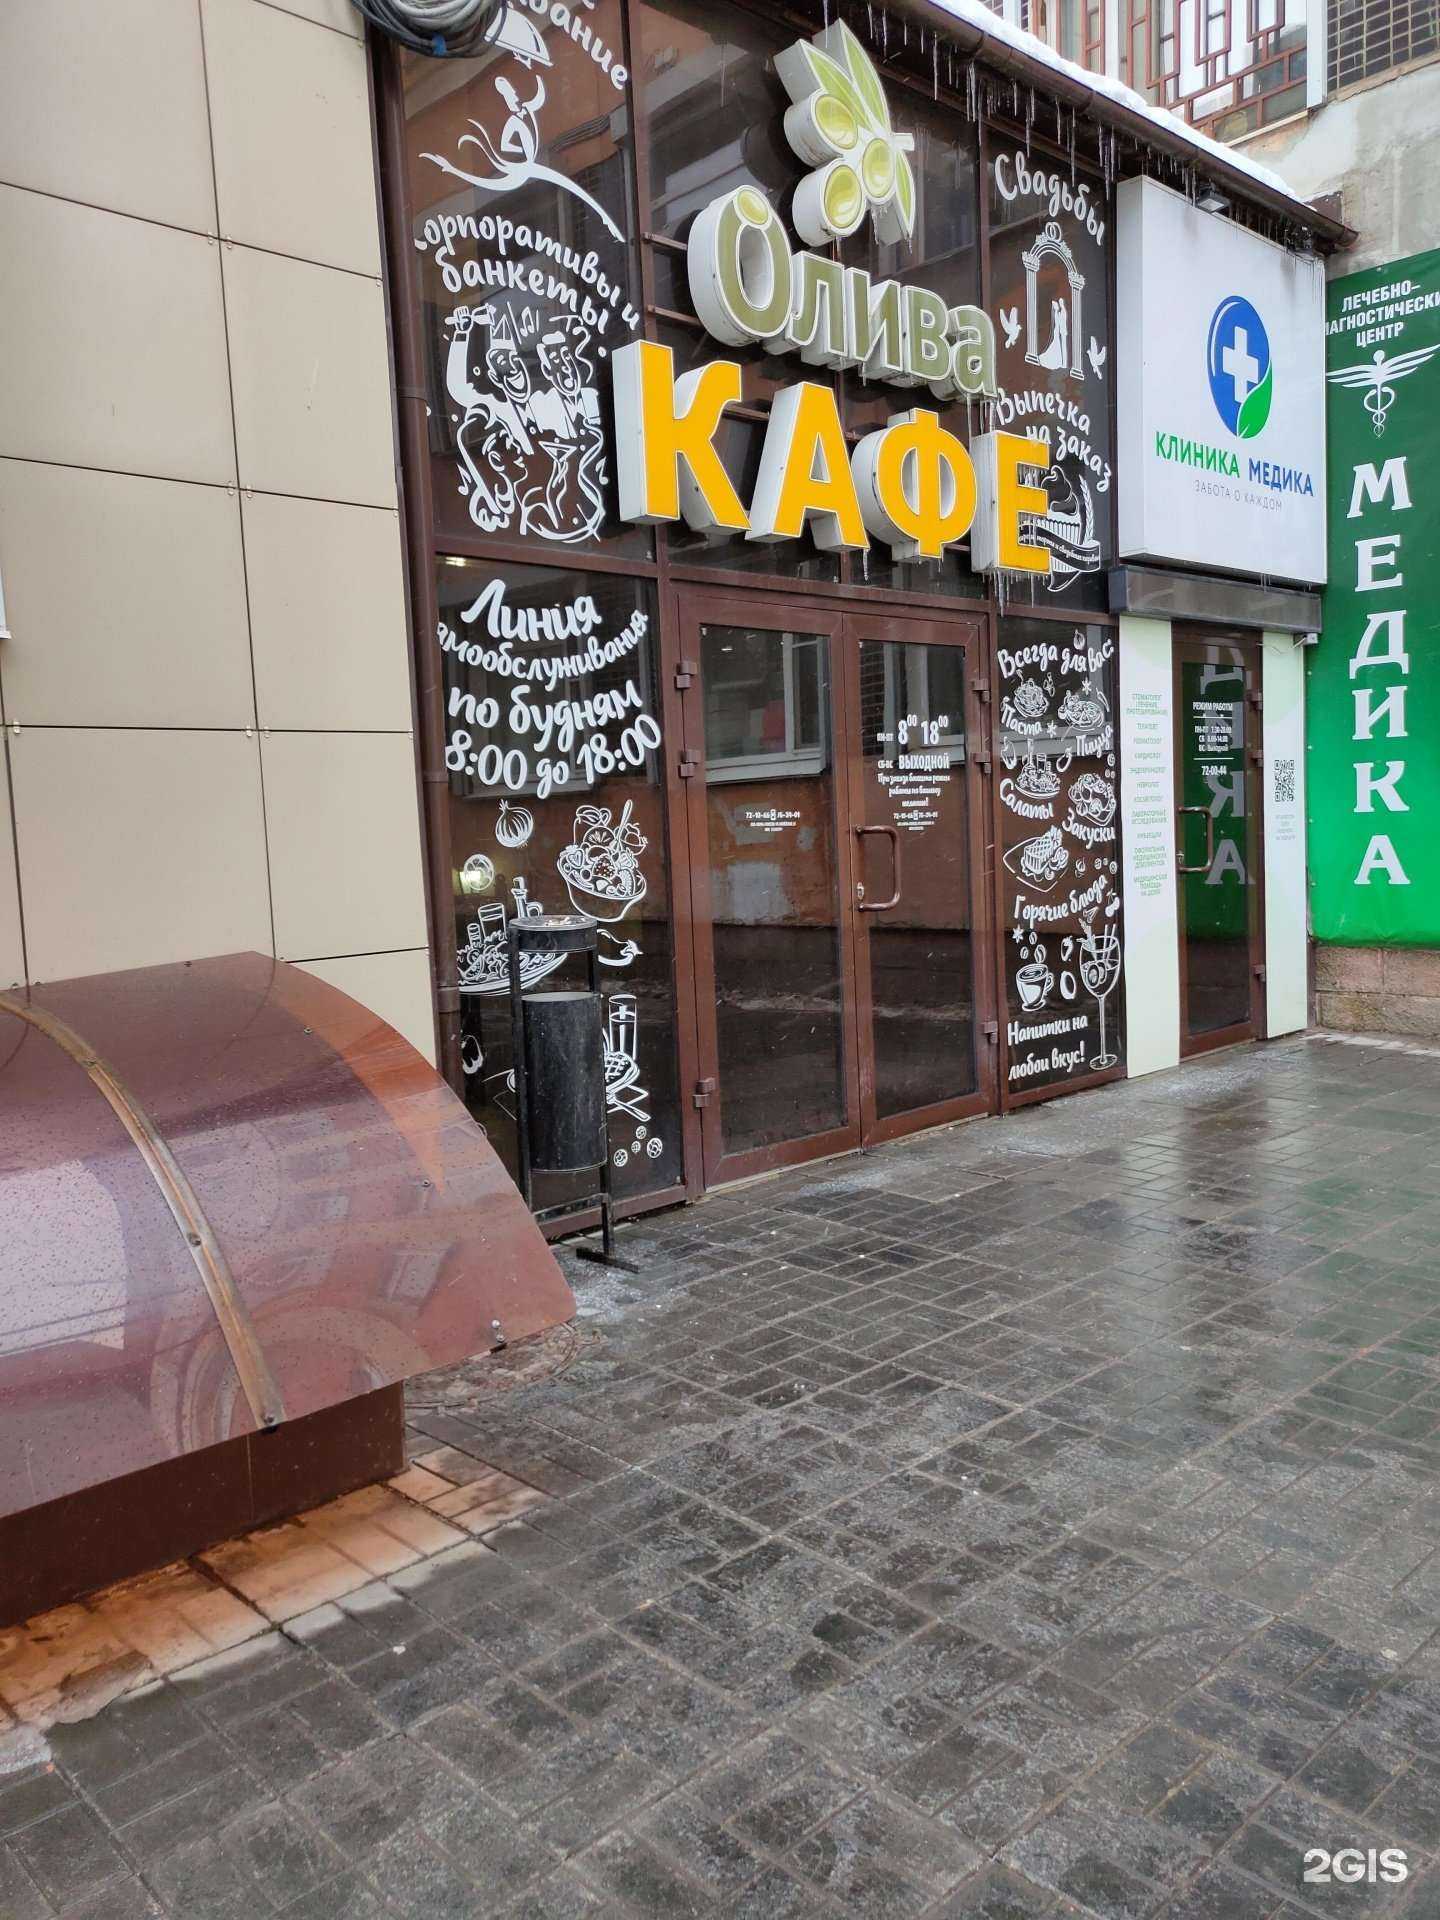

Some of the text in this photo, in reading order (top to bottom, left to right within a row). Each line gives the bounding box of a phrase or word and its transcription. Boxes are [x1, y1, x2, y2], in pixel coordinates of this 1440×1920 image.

[994, 151, 1105, 246] Свадьбы
[414, 214, 620, 307] орпоративы
[434, 246, 609, 334] банкеты
[688, 184, 998, 400] Олива
[1341, 279, 1421, 313] ЛЕЧЕБНО-
[1356, 322, 1404, 348] ЦЕНТР
[996, 388, 1091, 436] Выпечка
[613, 340, 1051, 575] КАФЕ
[1055, 426, 1112, 493] заказ
[1156, 431, 1314, 497] КЛИНИКА МЕДИКА
[1193, 479, 1283, 512] ЗАБОТА О КАЖДОМ
[460, 578, 602, 643] Линия
[436, 609, 649, 692] амообслуживания
[997, 642, 1058, 679] Всегда
[1060, 647, 1088, 676] для
[1346, 455, 1413, 886] МЕДИКА
[448, 679, 644, 753] по будням
[1001, 703, 1043, 736] Паста
[1075, 725, 1114, 759] Пицца
[445, 713, 662, 800] 8:00 до 18:00
[898, 753, 951, 771] ВЫХОДНОЙ
[1000, 778, 1054, 820] Салаты
[1062, 808, 1116, 849] Закуски
[1014, 874, 1108, 929] Горячие блюда
[1008, 1015, 1088, 1047] Напитки на
[1051, 1041, 1086, 1073] вкус!
